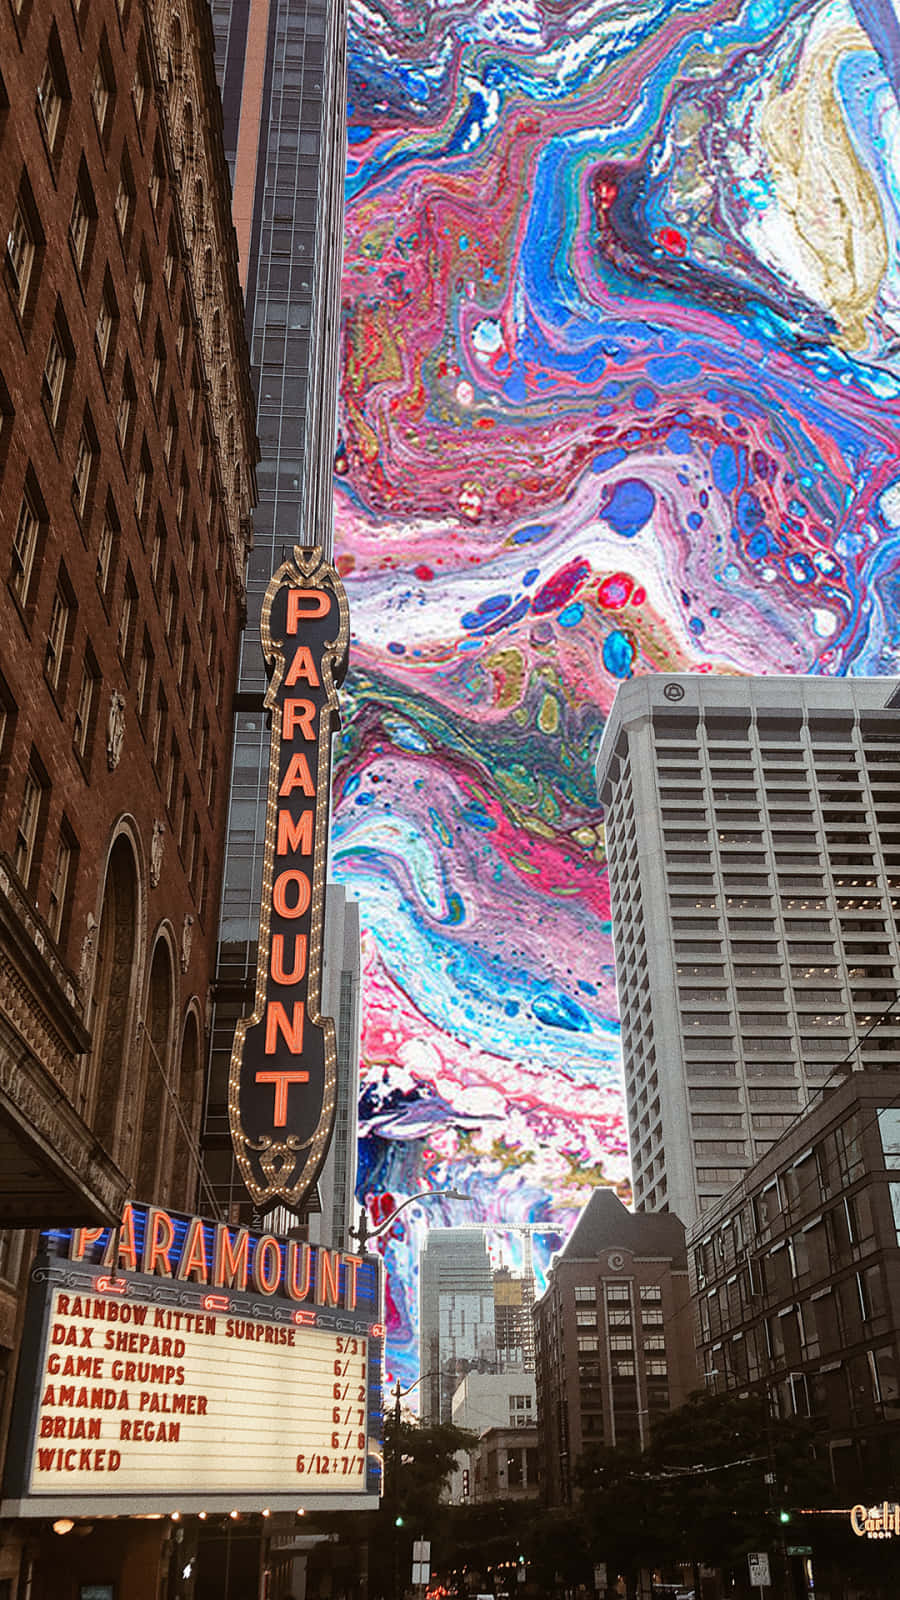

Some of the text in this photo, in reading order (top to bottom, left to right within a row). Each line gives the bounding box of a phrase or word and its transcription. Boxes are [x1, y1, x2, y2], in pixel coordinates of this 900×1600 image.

[255, 589, 331, 1127] PARAMOUNT
[56, 1294, 148, 1326] RAINBOW
[153, 1308, 217, 1336] KITTEN
[225, 1319, 296, 1347] SURPRISE
[52, 1323, 94, 1348] DAX
[104, 1329, 186, 1358] SHEPARD
[47, 1353, 104, 1379] GAME
[111, 1360, 185, 1385] GRUMPS
[41, 1384, 129, 1410] AMANDA
[139, 1392, 208, 1415] PALMER
[39, 1415, 101, 1439] BRIAN
[119, 1419, 181, 1442] REGAN
[38, 1447, 121, 1471] WICKED
